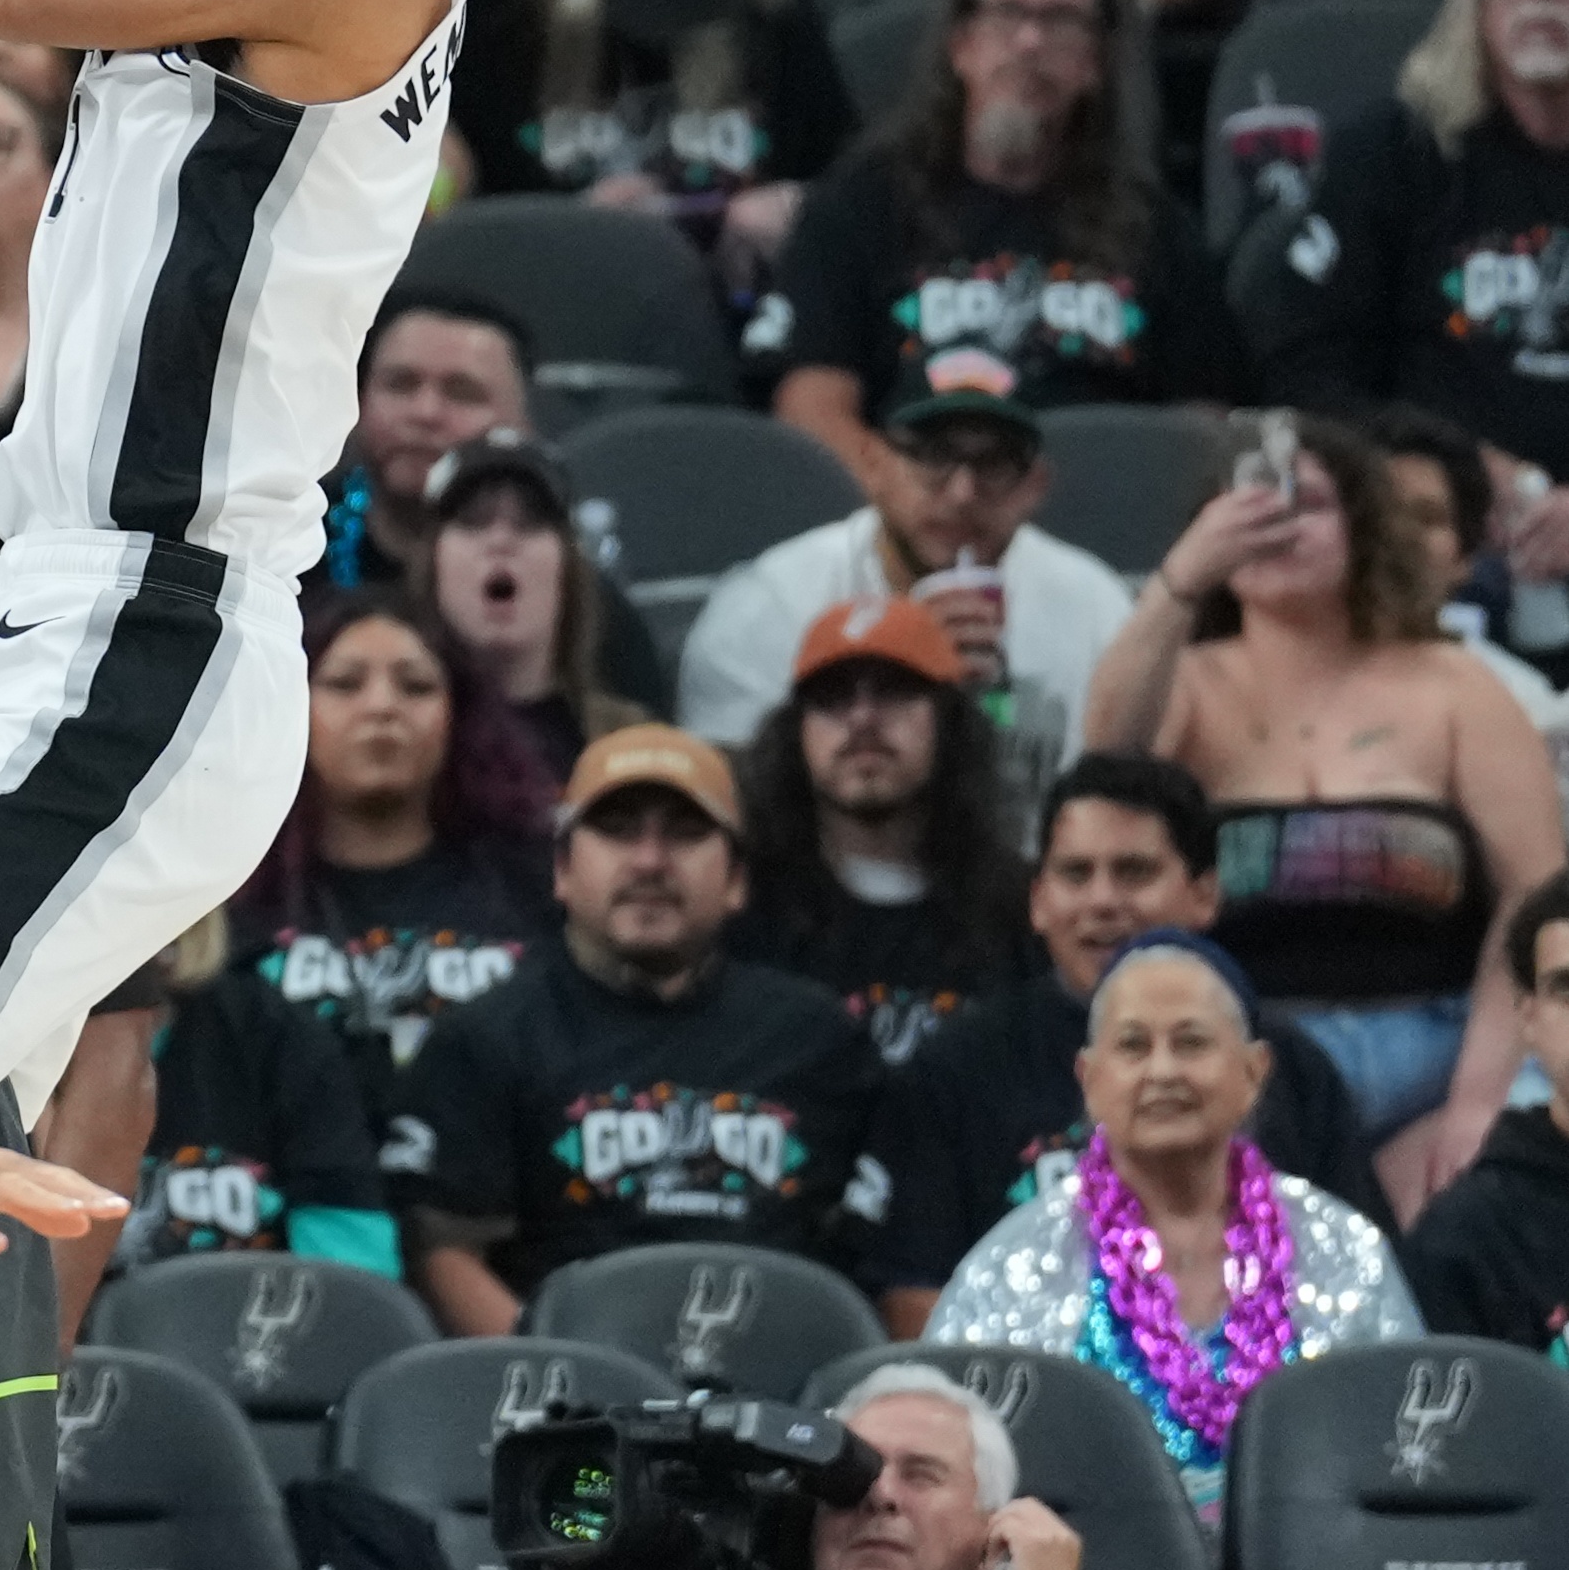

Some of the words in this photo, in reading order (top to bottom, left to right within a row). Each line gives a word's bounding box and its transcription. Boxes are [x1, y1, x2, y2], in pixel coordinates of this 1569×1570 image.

[582, 1108, 666, 1184] GO
[711, 1111, 785, 1191] GO
[166, 1164, 259, 1239] GO
